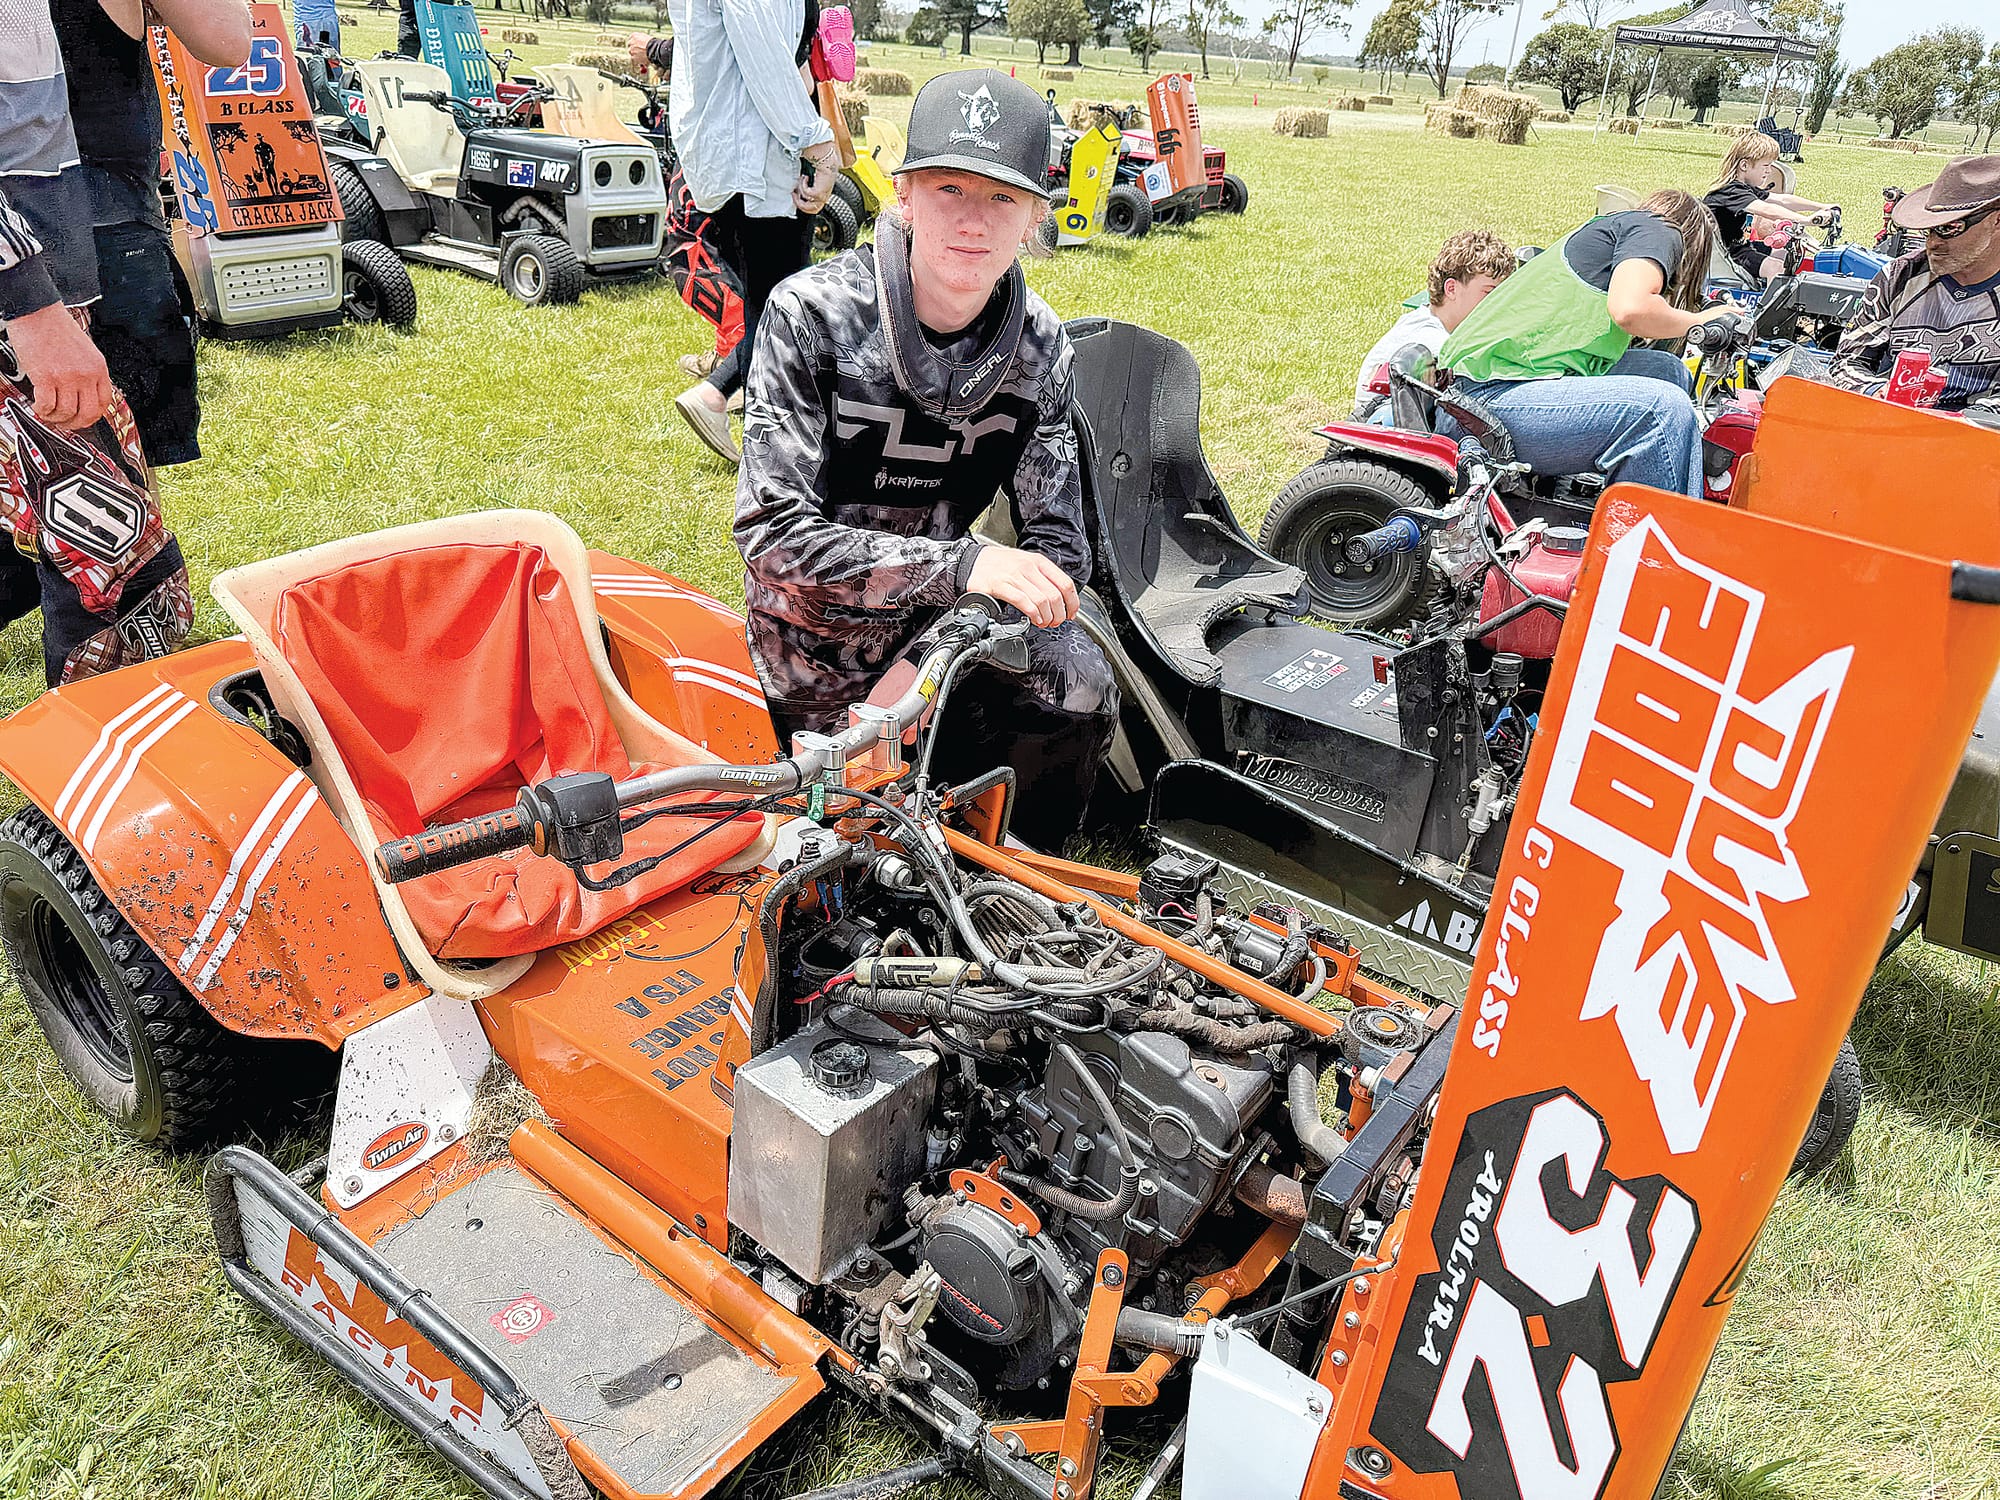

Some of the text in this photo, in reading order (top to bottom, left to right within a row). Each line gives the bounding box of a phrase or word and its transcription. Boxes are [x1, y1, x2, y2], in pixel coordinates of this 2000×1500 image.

[152, 25, 178, 87] RACKA
[425, 27, 447, 70] DRIF
[1619, 30, 1658, 41] AUSTRALIAN
[1686, 34, 1704, 44] LAWN
[1732, 37, 1776, 49] ASSOCIATION
[205, 36, 287, 97] 25
[220, 100, 294, 116] B CLASS
[1157, 129, 1182, 155] 66
[173, 151, 218, 229] 25
[232, 201, 337, 226] CRACKA JACK
[1741, 292, 1761, 309] HG
[888, 476, 943, 489] KRYPTEK
[143, 624, 165, 658] SHIF
[1640, 655, 1848, 1115] DUKE
[556, 910, 667, 975] LEMON
[1444, 910, 1484, 956] B
[1471, 826, 1554, 1060] C CLASS
[614, 968, 705, 1018] ITS A
[651, 1044, 719, 1091] NOT
[1798, 1112, 1833, 1163] KEND
[1419, 1146, 1503, 1370] AROLMRA
[1425, 1093, 1700, 1500] 32
